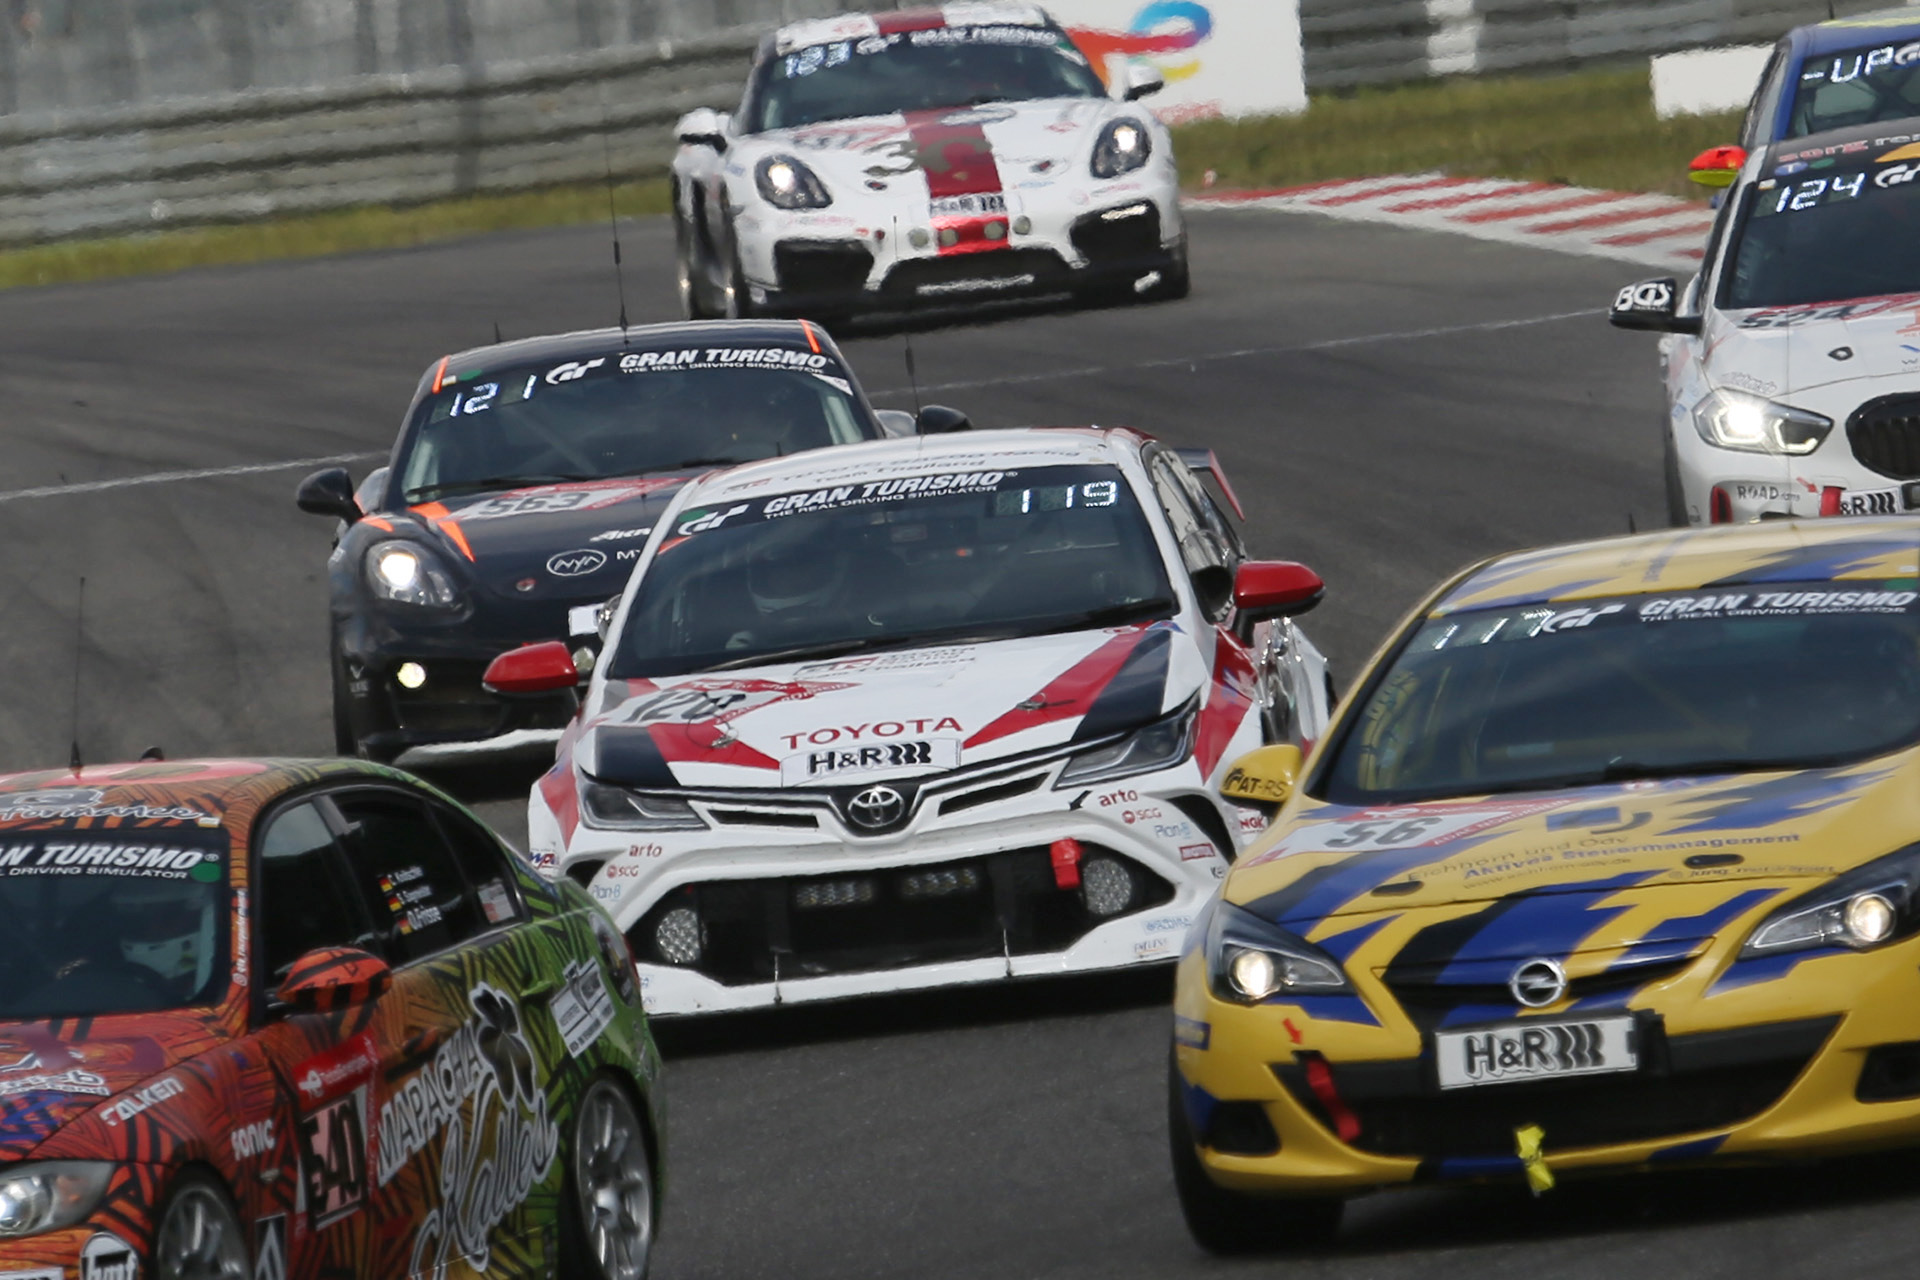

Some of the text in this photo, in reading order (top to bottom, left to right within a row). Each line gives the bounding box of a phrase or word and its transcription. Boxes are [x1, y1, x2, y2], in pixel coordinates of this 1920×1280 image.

[1776, 173, 1865, 213] 124
[619, 349, 826, 369] GRAN TURISMO
[651, 363, 686, 371] REAL
[689, 361, 741, 369] DRIVING
[746, 361, 824, 374] SIMULATOR
[813, 458, 986, 484] Team Thailand
[479, 492, 589, 516] 563
[763, 485, 854, 515] GRAN
[764, 484, 998, 520] THE REAL DRIVING SIMULATOR
[1021, 480, 1118, 514] 119
[1737, 486, 1779, 500] ROAD
[1639, 591, 1918, 617] GRAN TURISMO
[1640, 605, 1907, 623] THE REAL DRIVING SIMULATOR
[779, 716, 963, 750] TOYOTA
[808, 749, 882, 776] H&R
[1098, 788, 1138, 808] arto
[1240, 817, 1265, 830] NGK
[1324, 817, 1443, 849] 56
[628, 843, 663, 858] arto
[1407, 852, 1516, 882] Eichhorn
[1525, 841, 1572, 856] und
[1464, 833, 1801, 880] Aktives Steuermanagement
[9, 866, 81, 877] DRIVING
[86, 867, 189, 879] SIMULATOR
[1464, 1028, 1548, 1077] H&R
